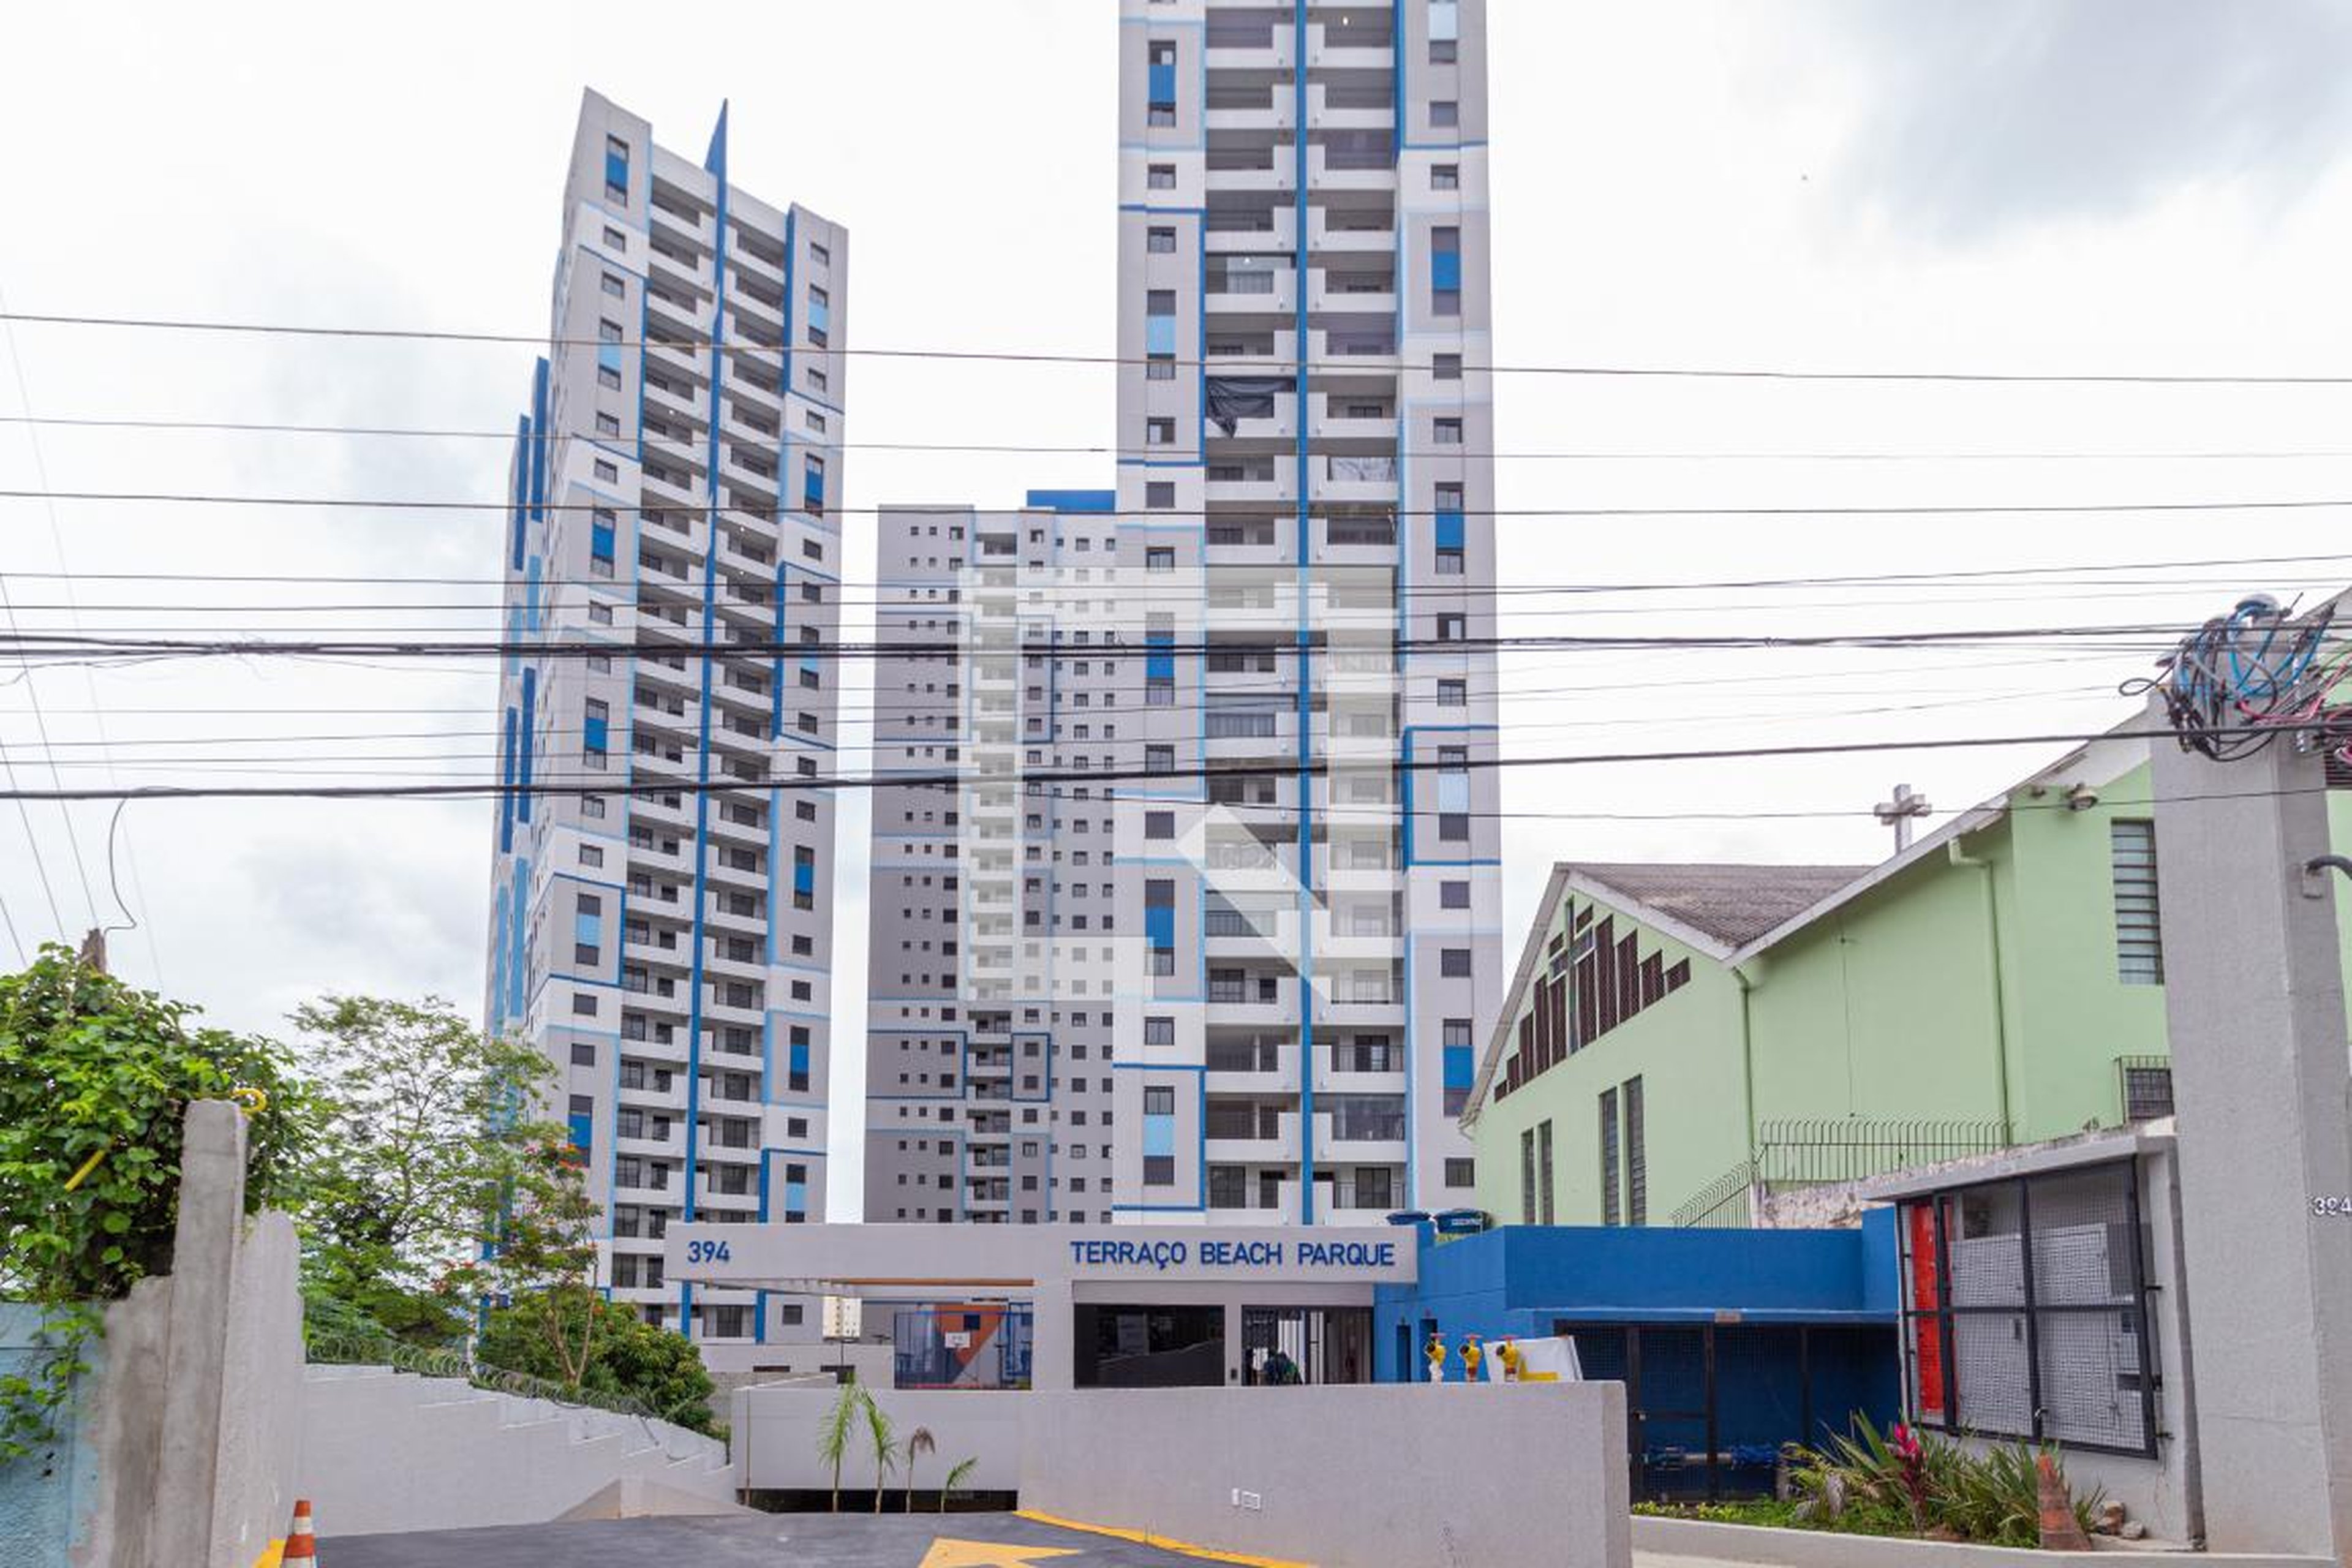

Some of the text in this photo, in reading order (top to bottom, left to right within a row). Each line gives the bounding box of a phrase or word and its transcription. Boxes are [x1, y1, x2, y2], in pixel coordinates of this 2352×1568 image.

[2313, 1197, 2352, 1216] 394
[688, 1241, 730, 1263] 394
[1071, 1241, 1395, 1270] TERRAÇO BEACH PARQUE
